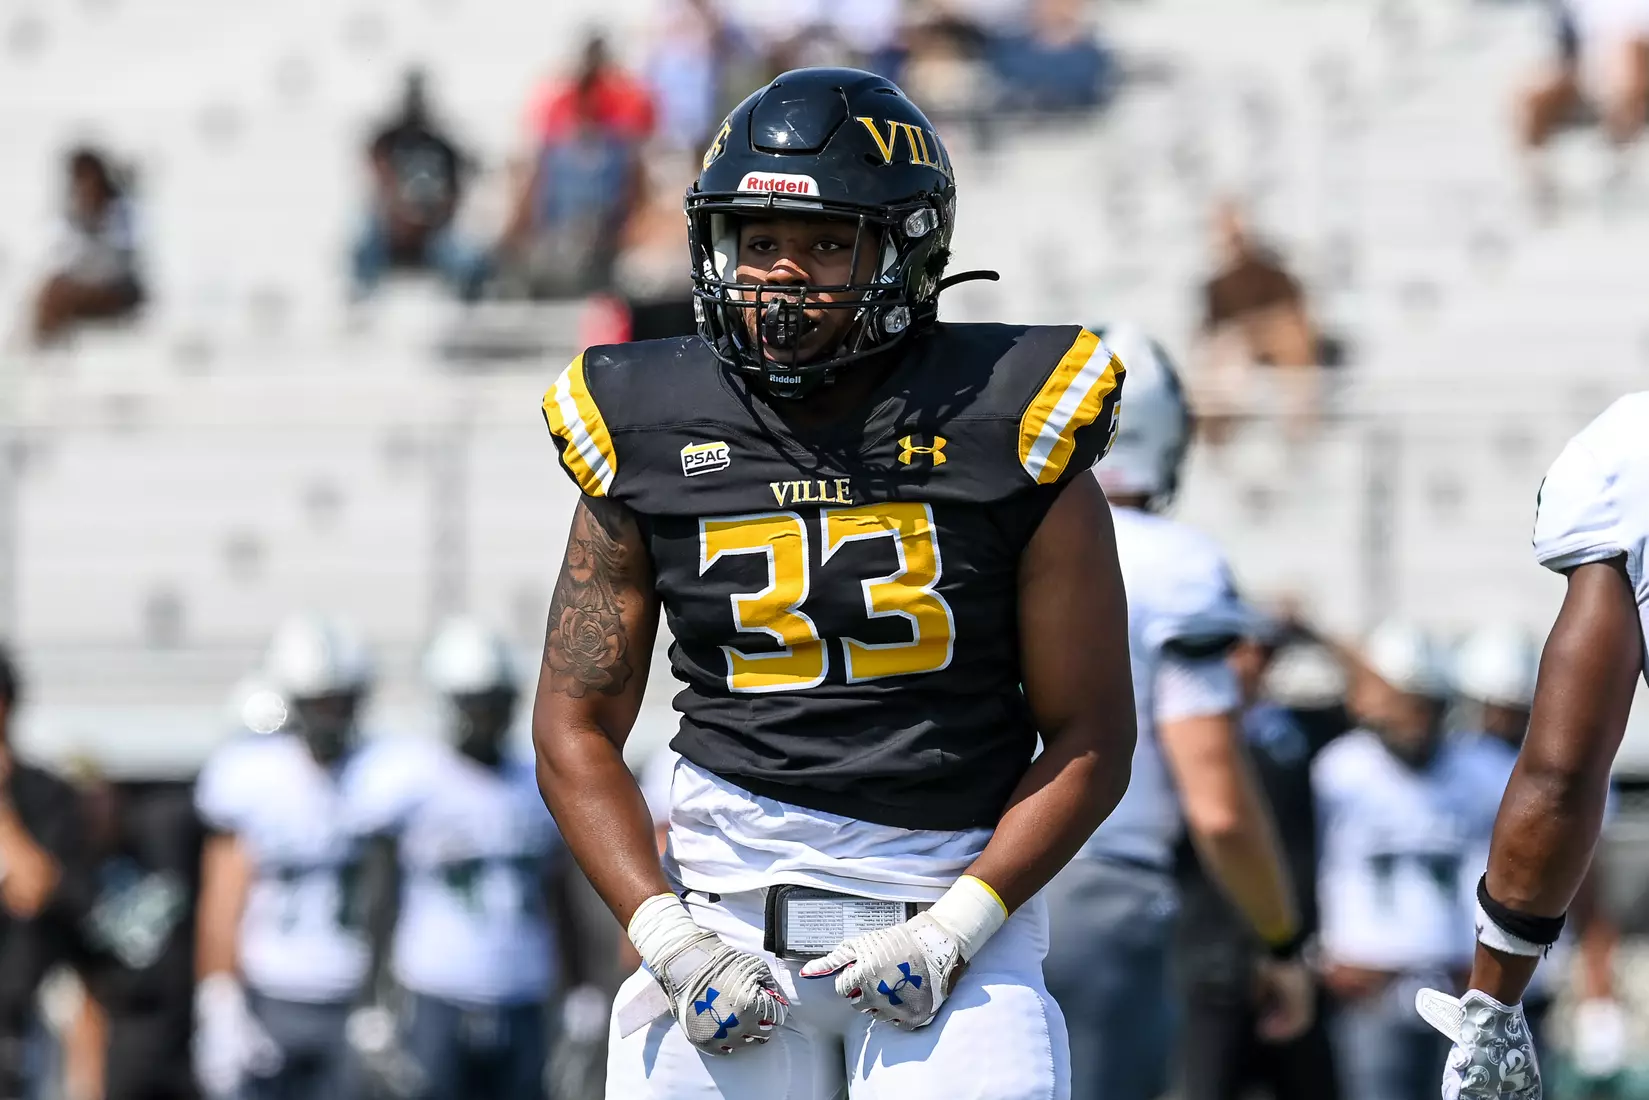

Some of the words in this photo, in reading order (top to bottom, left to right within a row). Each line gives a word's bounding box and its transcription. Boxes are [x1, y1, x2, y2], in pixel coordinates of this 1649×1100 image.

[746, 176, 809, 194] Riddell
[769, 374, 802, 384] Riddell
[684, 448, 727, 468] PSAC
[769, 478, 853, 507] VILLE
[698, 502, 956, 693] 33
